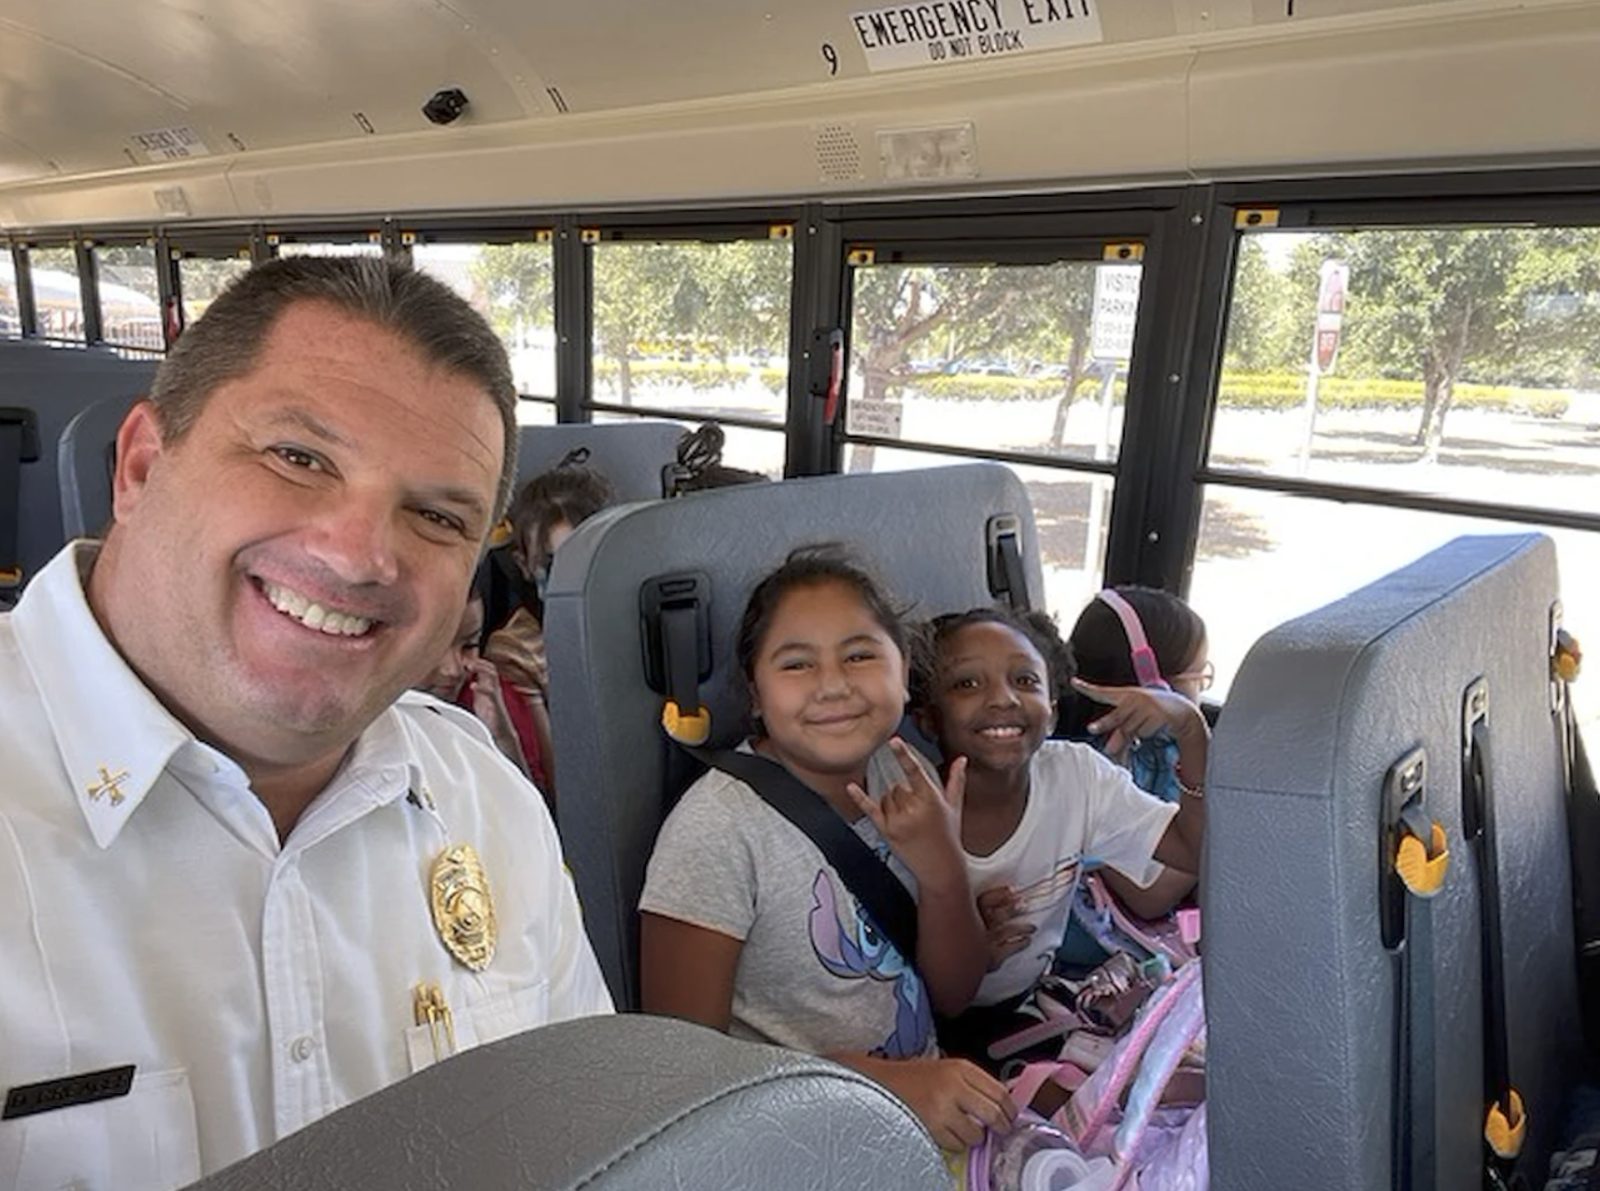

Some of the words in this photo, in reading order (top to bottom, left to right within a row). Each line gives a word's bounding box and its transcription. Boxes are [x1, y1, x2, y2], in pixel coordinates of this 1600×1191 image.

[853, 0, 1002, 48] EMERGENCY
[822, 43, 838, 76] 9
[928, 41, 946, 60] DO
[949, 36, 972, 57] NOT
[978, 30, 1024, 54] BLOCK
